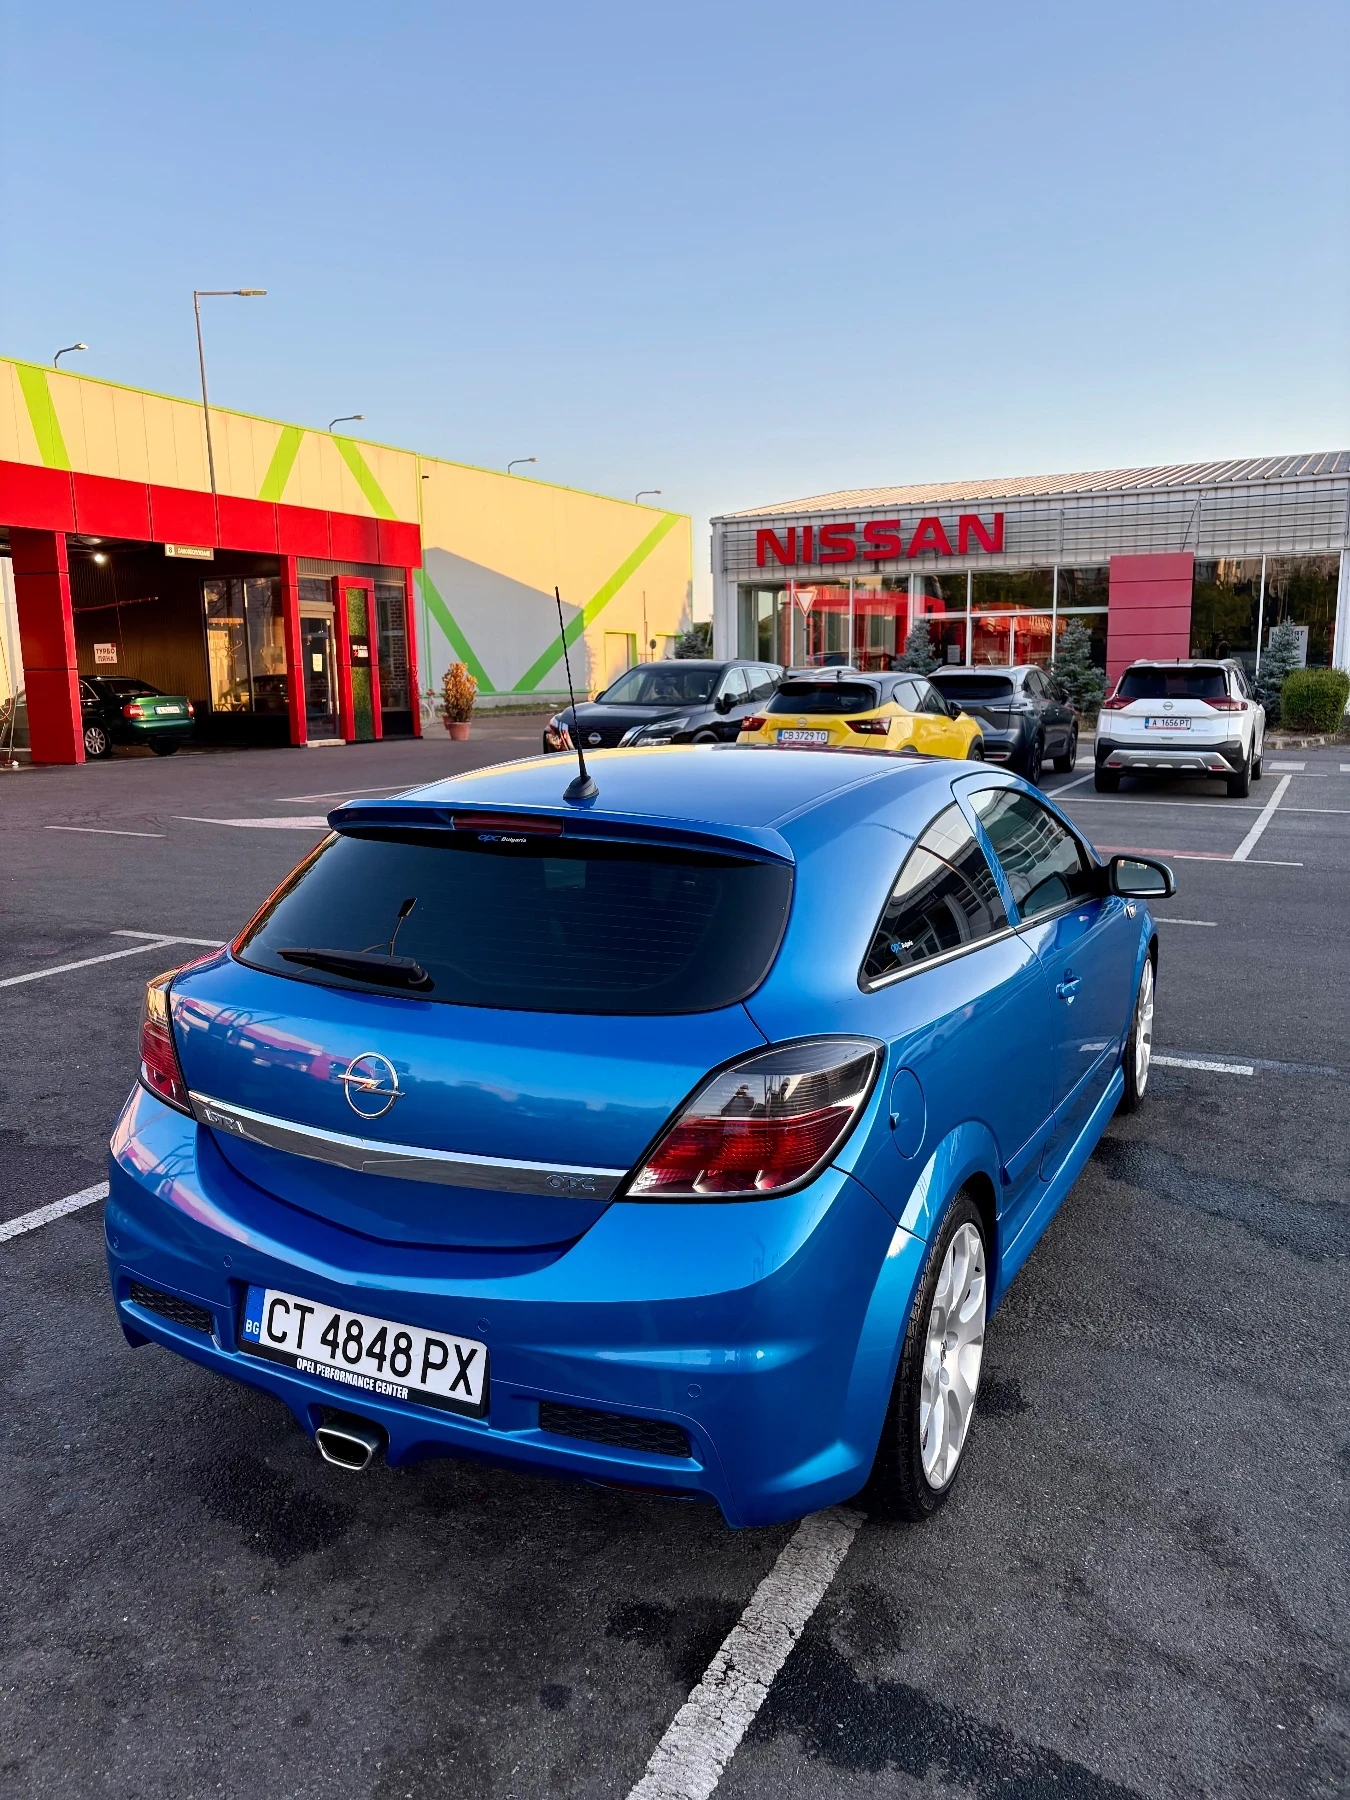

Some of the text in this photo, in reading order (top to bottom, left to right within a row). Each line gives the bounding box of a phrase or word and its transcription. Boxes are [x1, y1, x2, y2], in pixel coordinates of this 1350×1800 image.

[756, 512, 1004, 566] NISSAN
[783, 731, 794, 740] CB
[795, 731, 814, 740] 3729
[501, 836, 527, 844] Bulgaria
[203, 1109, 245, 1134] ASTRA
[546, 1174, 596, 1193] OPC
[245, 1319, 260, 1335] BG
[267, 1298, 478, 1396] CT 4848 PX
[296, 1357, 409, 1400] OPEL PERFORMANCE CENTER
